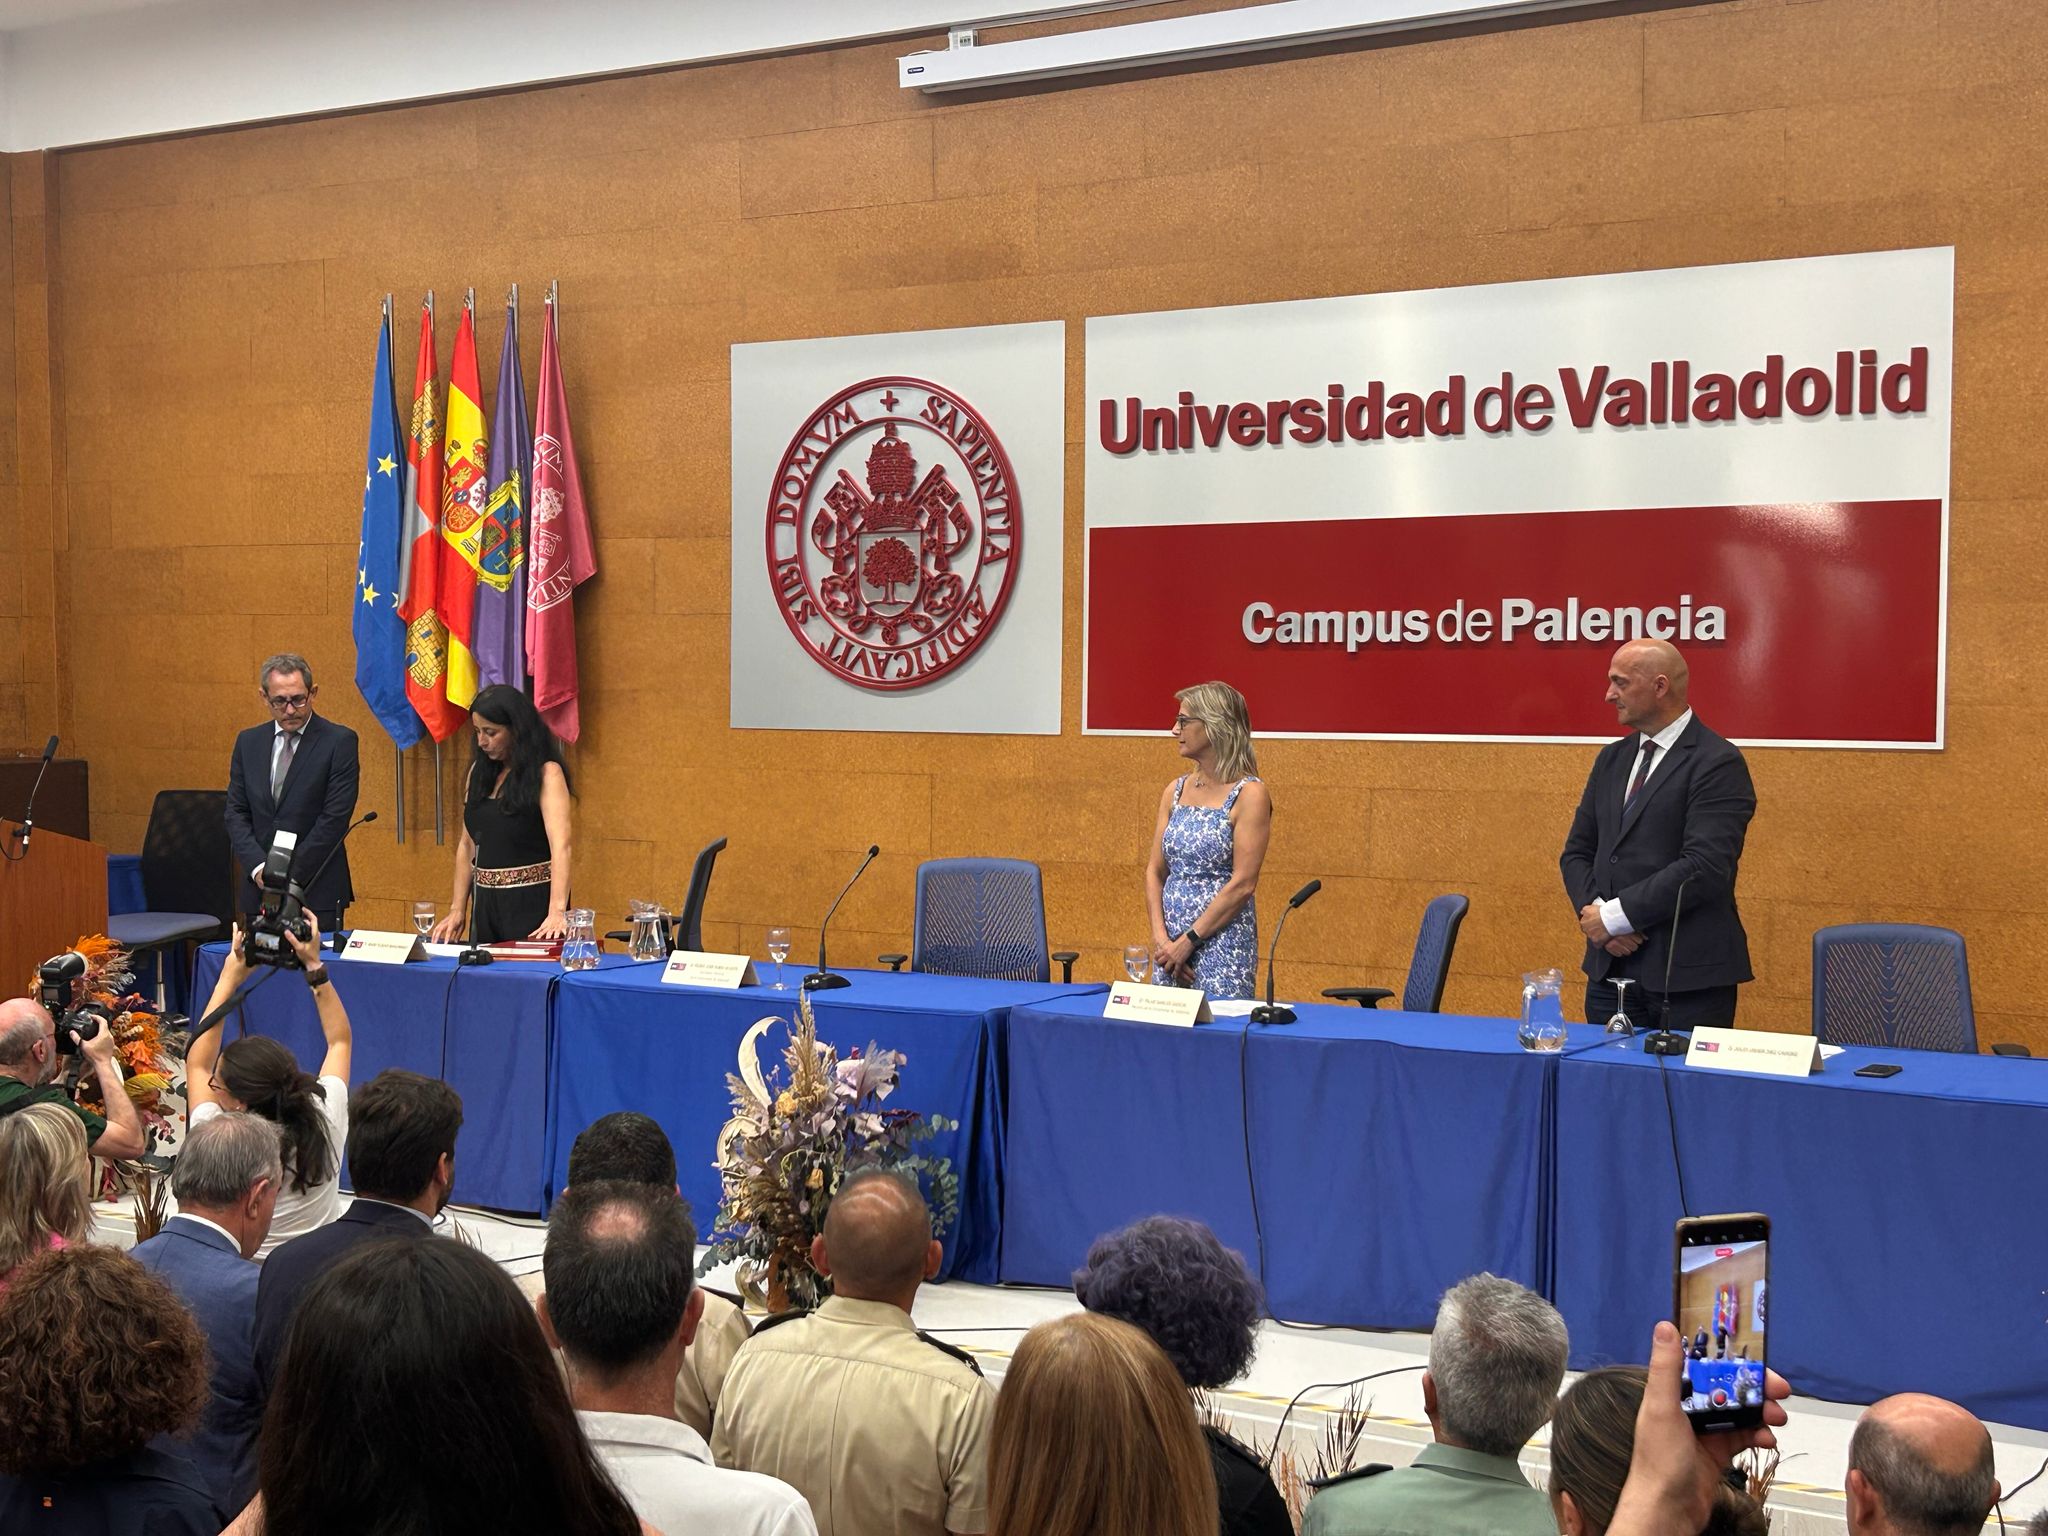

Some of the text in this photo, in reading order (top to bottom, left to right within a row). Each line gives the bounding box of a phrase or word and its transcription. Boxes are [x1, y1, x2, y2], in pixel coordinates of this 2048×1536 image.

[1099, 347, 1927, 453] Universidad de Valladolid
[774, 400, 863, 528] DOMVM
[919, 395, 1012, 567] SAPIENTIA
[776, 553, 819, 626] SIBI
[1242, 594, 1726, 653] Campus de Palencia
